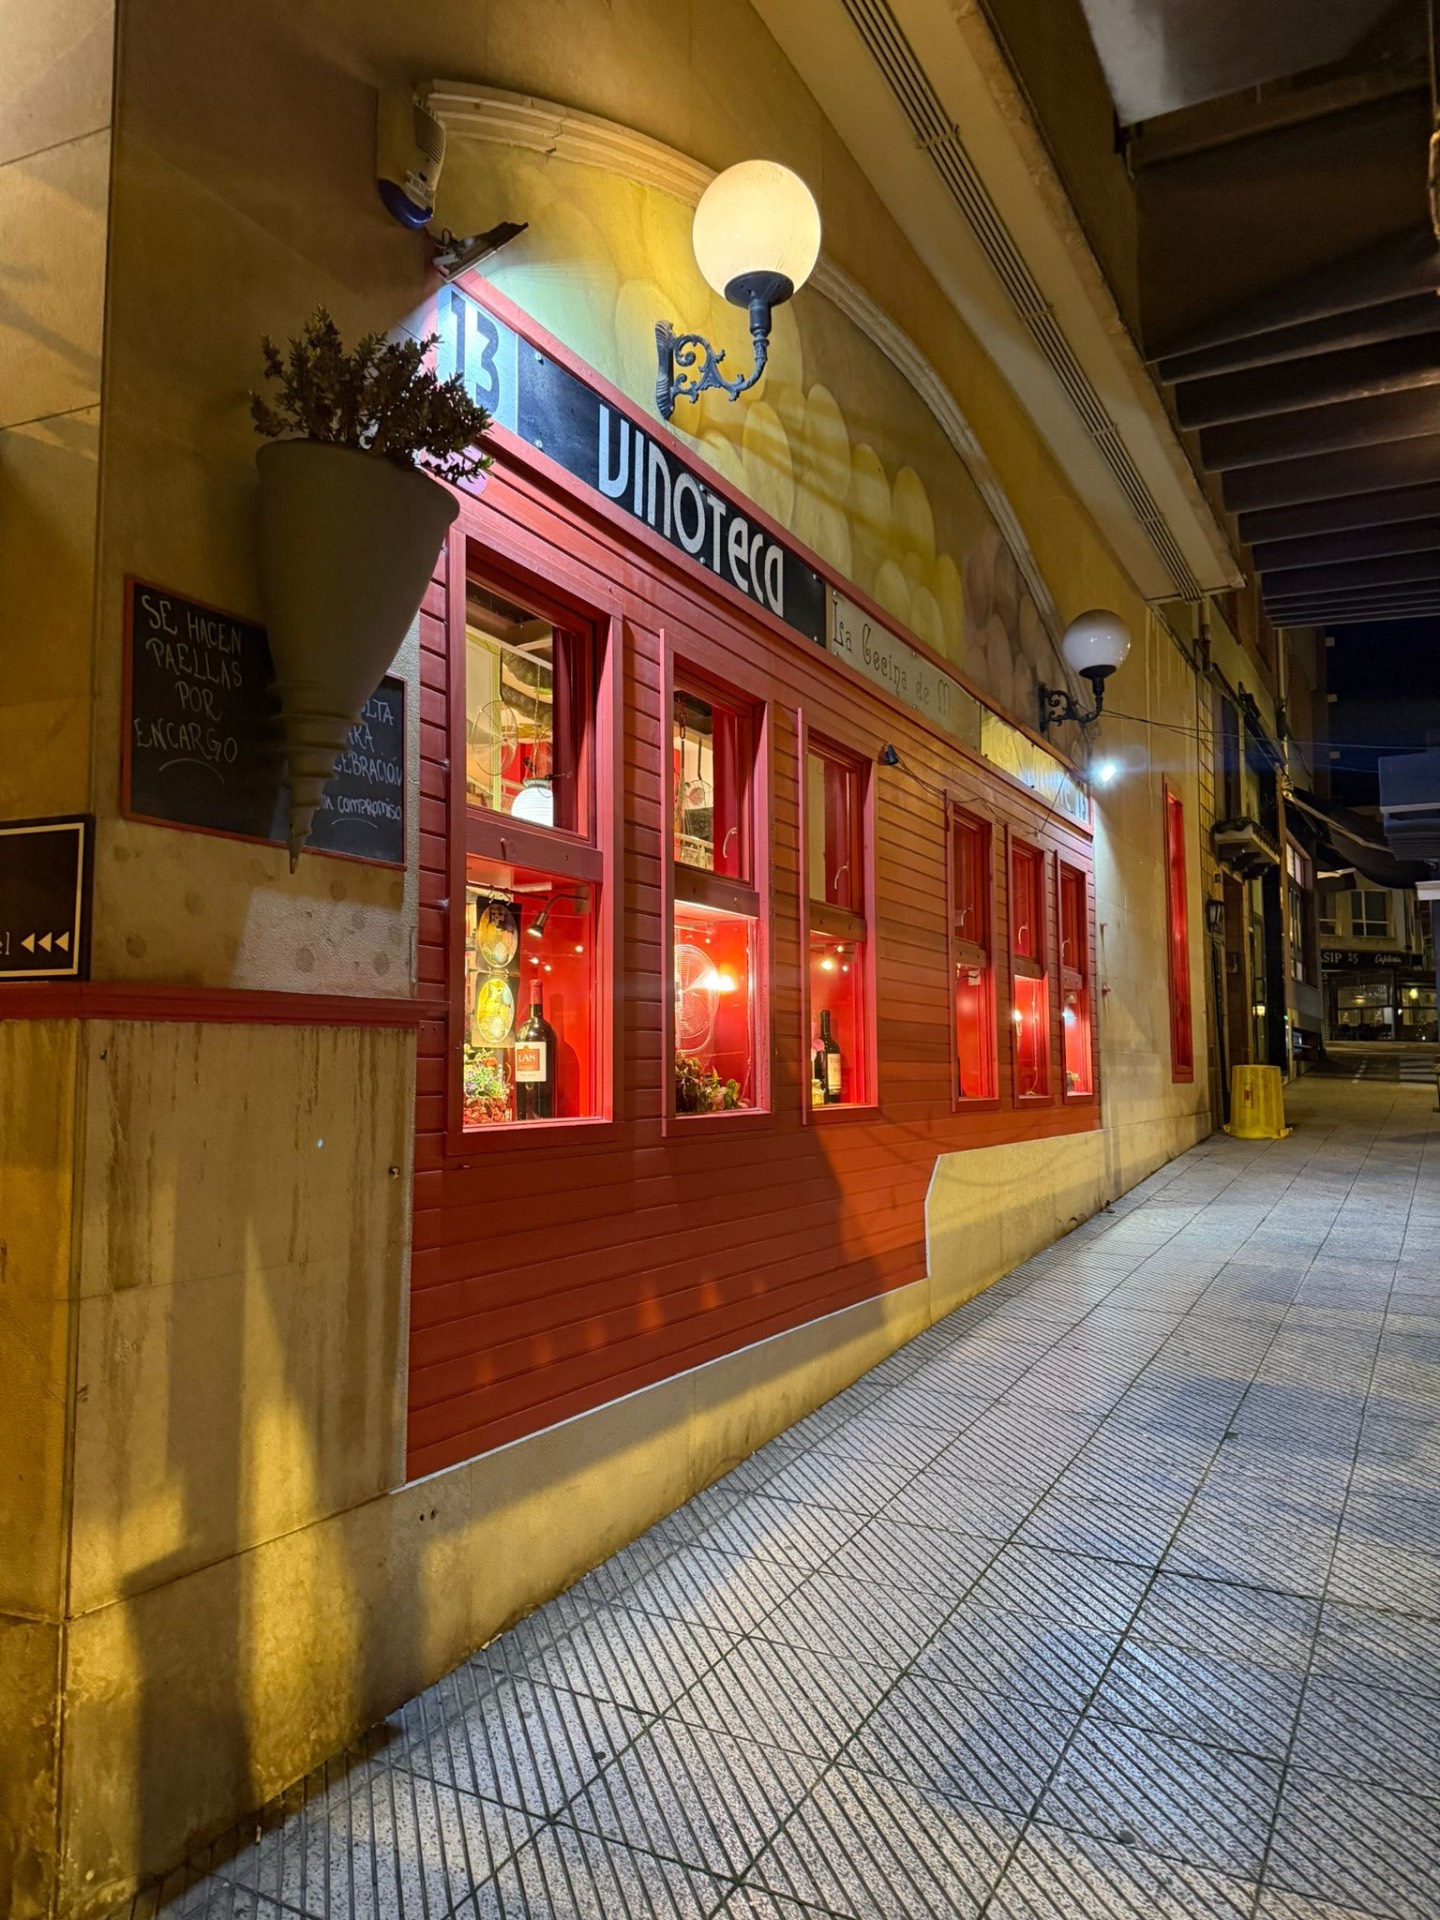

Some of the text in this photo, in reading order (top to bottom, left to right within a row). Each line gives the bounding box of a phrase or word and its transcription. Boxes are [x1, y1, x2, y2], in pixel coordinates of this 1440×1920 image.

[141, 594, 243, 657] SE HACEN
[145, 637, 244, 691] PAELLAS
[832, 599, 853, 653] La
[916, 671, 930, 705] de
[174, 680, 224, 723] POR
[361, 698, 395, 726] LTA
[133, 717, 239, 763] ENCARGO
[1320, 951, 1342, 964] SIP
[518, 1053, 536, 1063] LAN
